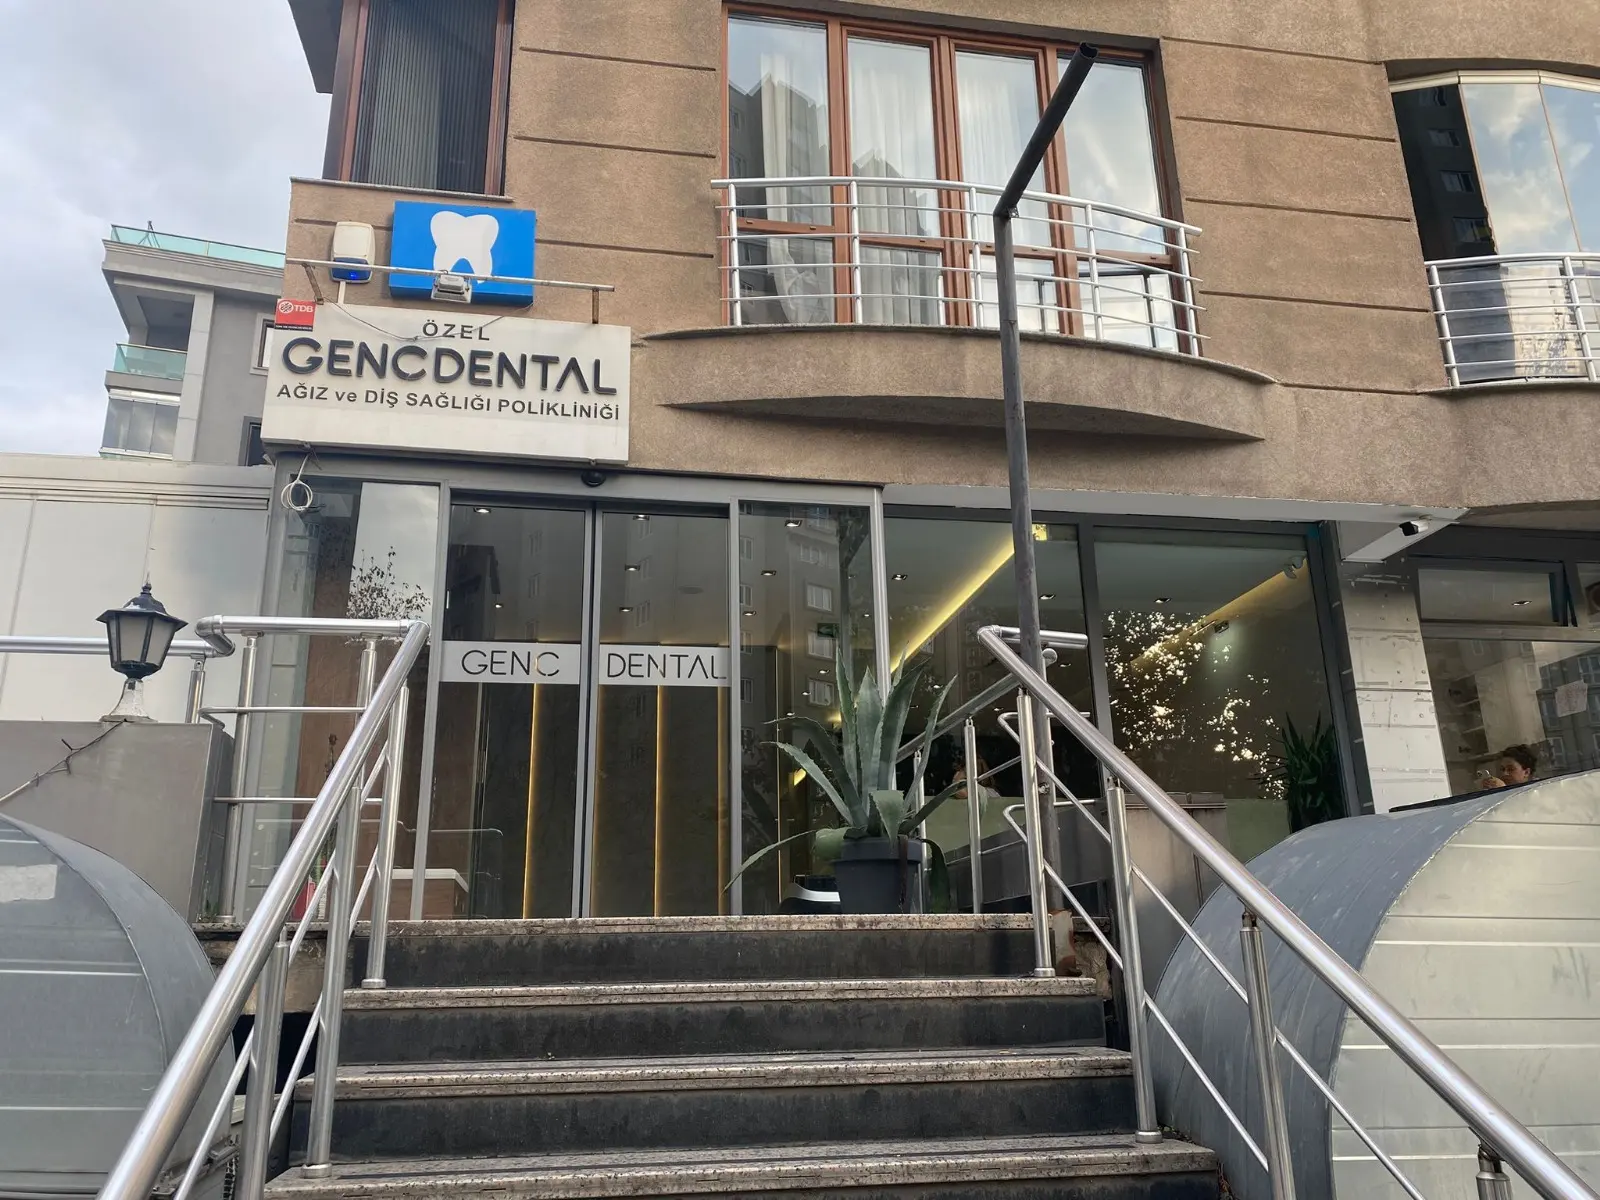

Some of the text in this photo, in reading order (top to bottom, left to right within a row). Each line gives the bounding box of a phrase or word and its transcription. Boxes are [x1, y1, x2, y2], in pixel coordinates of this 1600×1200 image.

[294, 304, 314, 313] TDB
[422, 319, 490, 341] ÖZEL
[276, 382, 620, 420] AĞIZ ve DİŞ SAĞLIĞI POLİKLİNİĞİ
[607, 653, 727, 679] DENTAL
